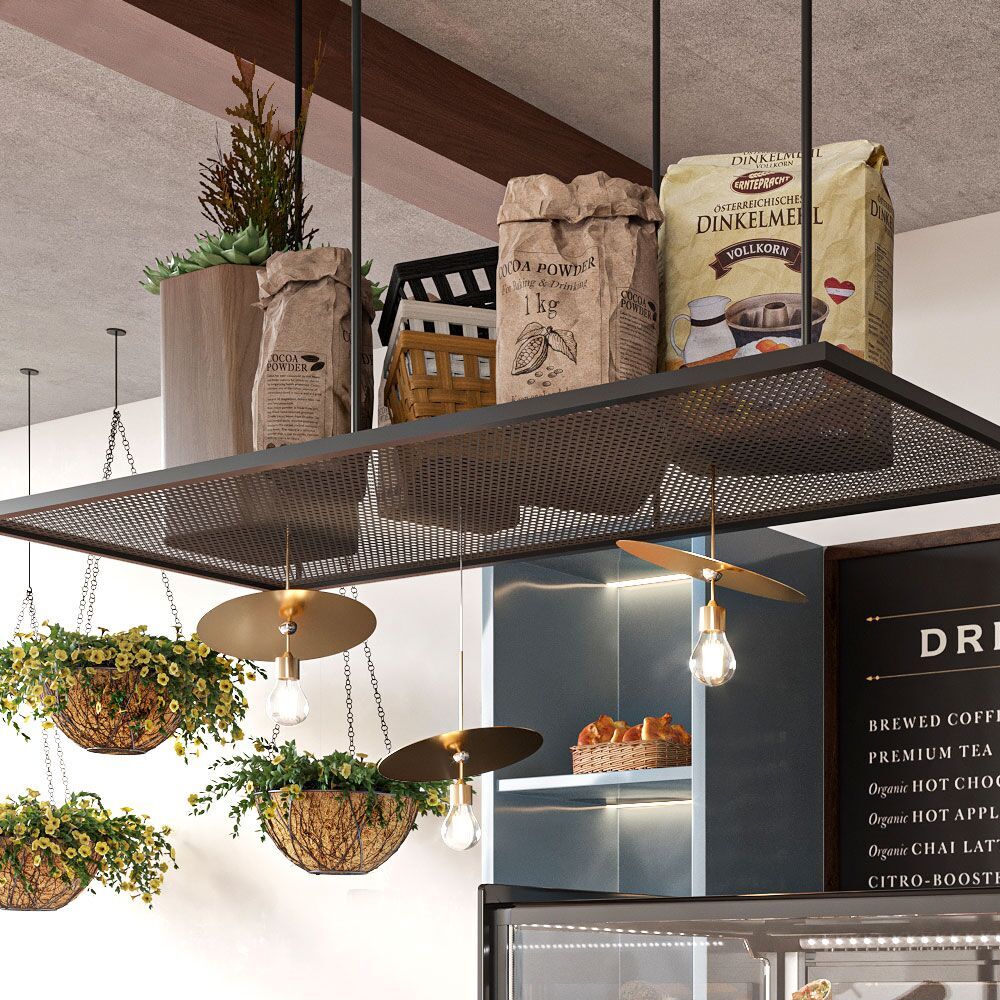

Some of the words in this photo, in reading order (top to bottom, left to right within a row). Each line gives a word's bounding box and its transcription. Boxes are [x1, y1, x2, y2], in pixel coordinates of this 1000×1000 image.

[734, 176, 791, 190] ERNTEPRACHT
[726, 243, 789, 260] VOLLKORN
[536, 256, 596, 277] POWDER
[538, 278, 548, 288] &
[524, 295, 530, 316] 1
[535, 292, 560, 319] kg
[620, 290, 648, 308] COCOA
[266, 363, 308, 372] POWDER
[869, 714, 941, 732] BREWED
[868, 746, 951, 764] PREMIUM
[958, 743, 993, 758] TEA
[868, 781, 908, 799] Organic
[912, 777, 950, 793] HOT
[868, 811, 909, 829] Organic
[912, 808, 950, 823] HOT
[868, 843, 908, 861] Organic
[911, 841, 955, 856] CHAI
